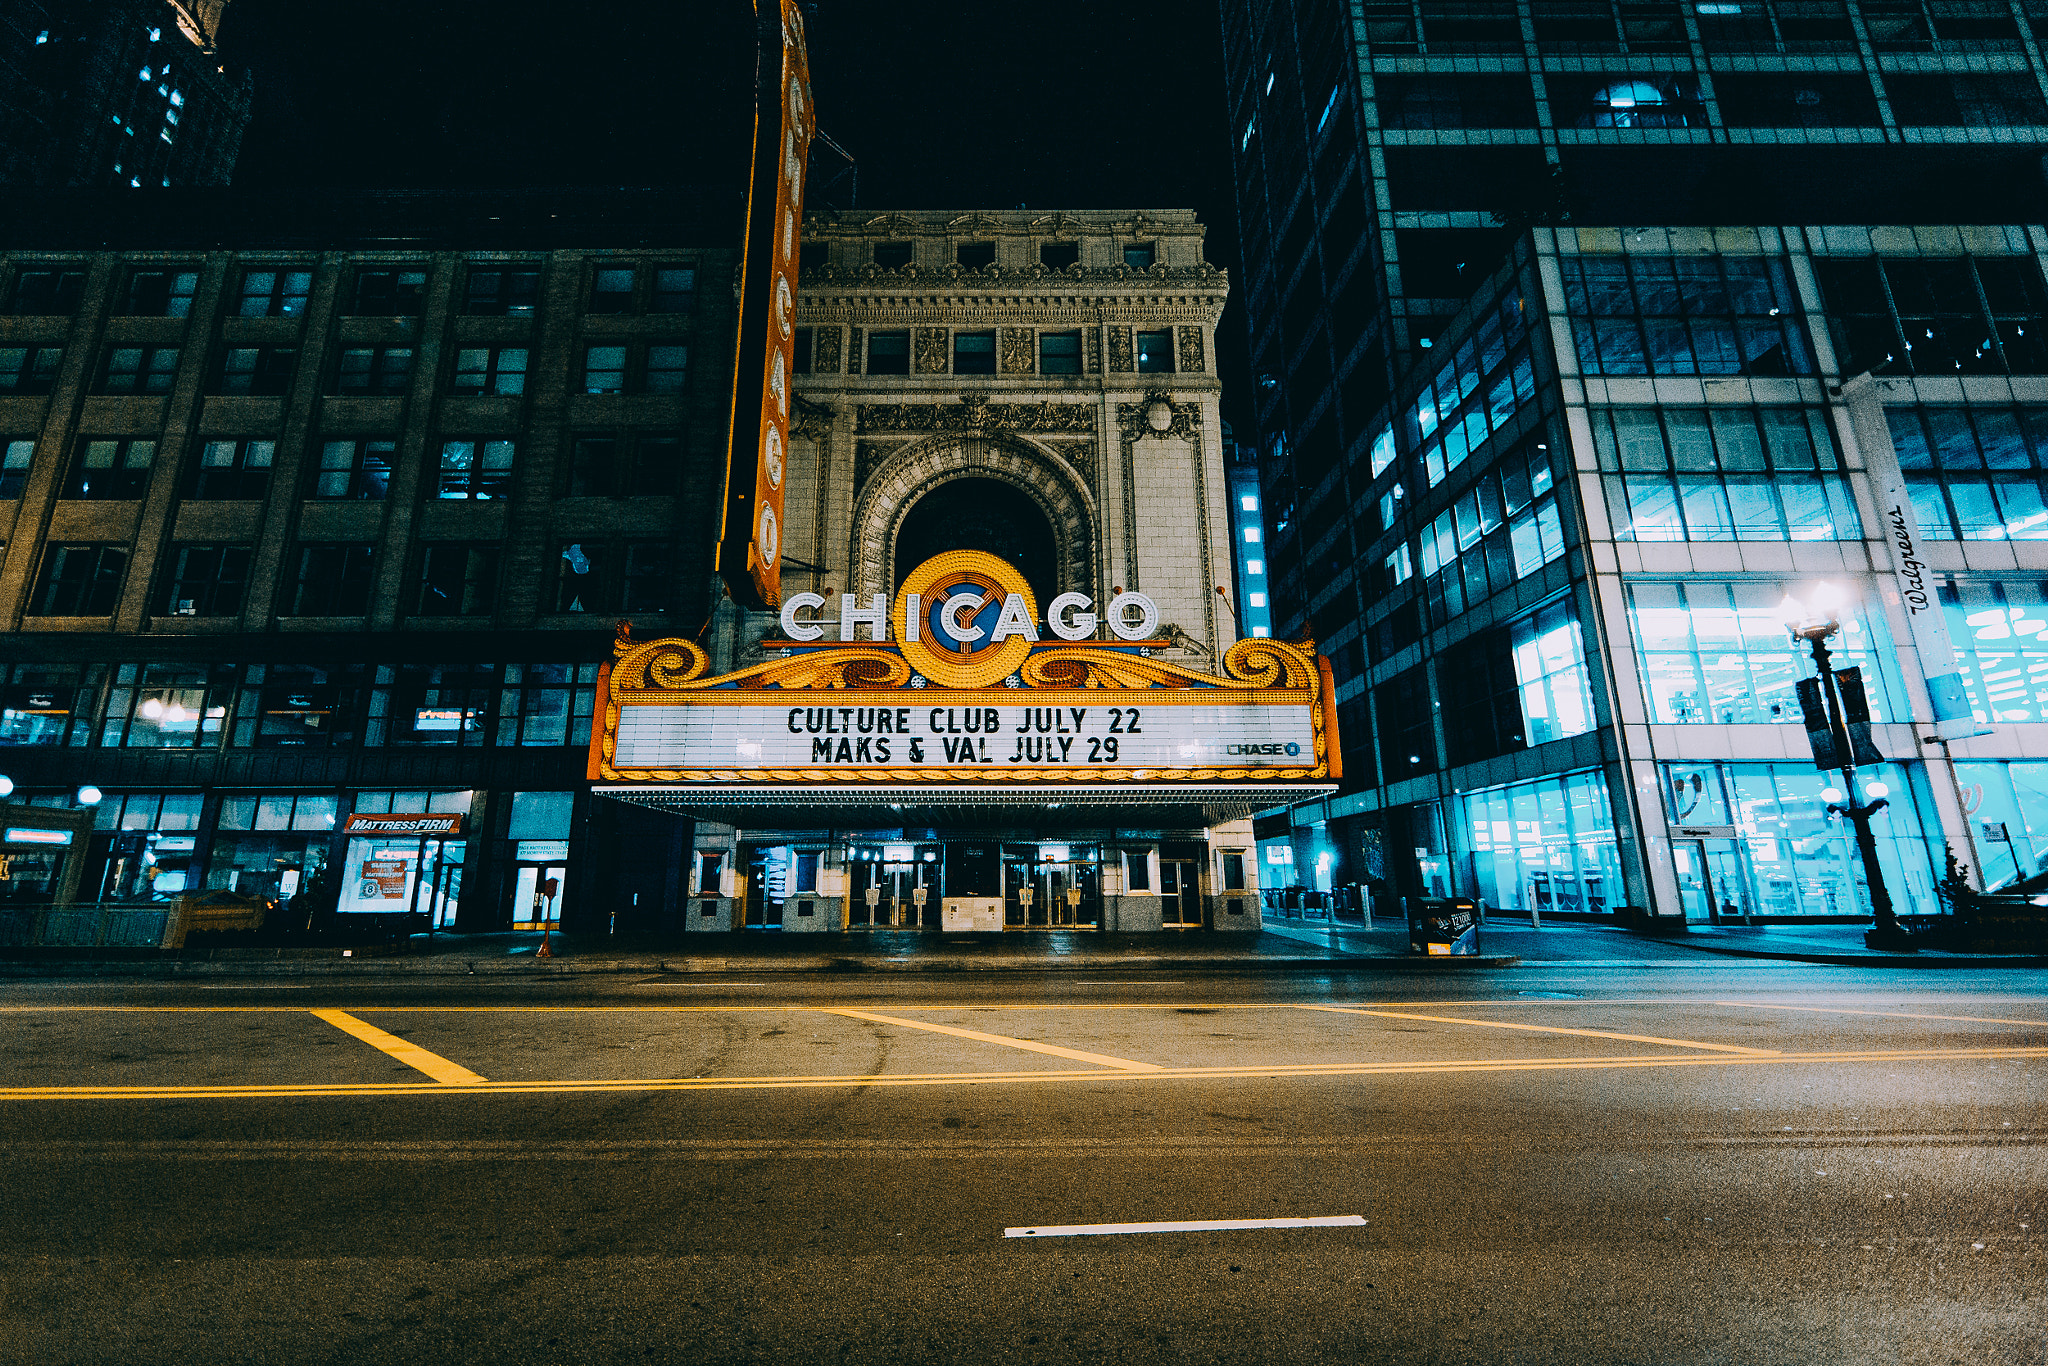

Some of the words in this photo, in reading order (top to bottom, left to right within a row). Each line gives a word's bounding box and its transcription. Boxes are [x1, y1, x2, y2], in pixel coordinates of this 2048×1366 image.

[759, 71, 804, 569] CHICAGO
[1888, 505, 1929, 615] Walgreens
[780, 592, 1159, 641] CHICAGO
[788, 708, 910, 733] CULTURE
[930, 708, 1000, 733] CLUB
[1016, 708, 1087, 733] JULY
[1108, 708, 1142, 733] 22
[811, 737, 891, 763] MAKS
[909, 737, 924, 763] &
[943, 737, 993, 763] VAL
[1008, 737, 1074, 763] JULY
[1087, 737, 1120, 763] 29
[1227, 744, 1283, 755] CHASE
